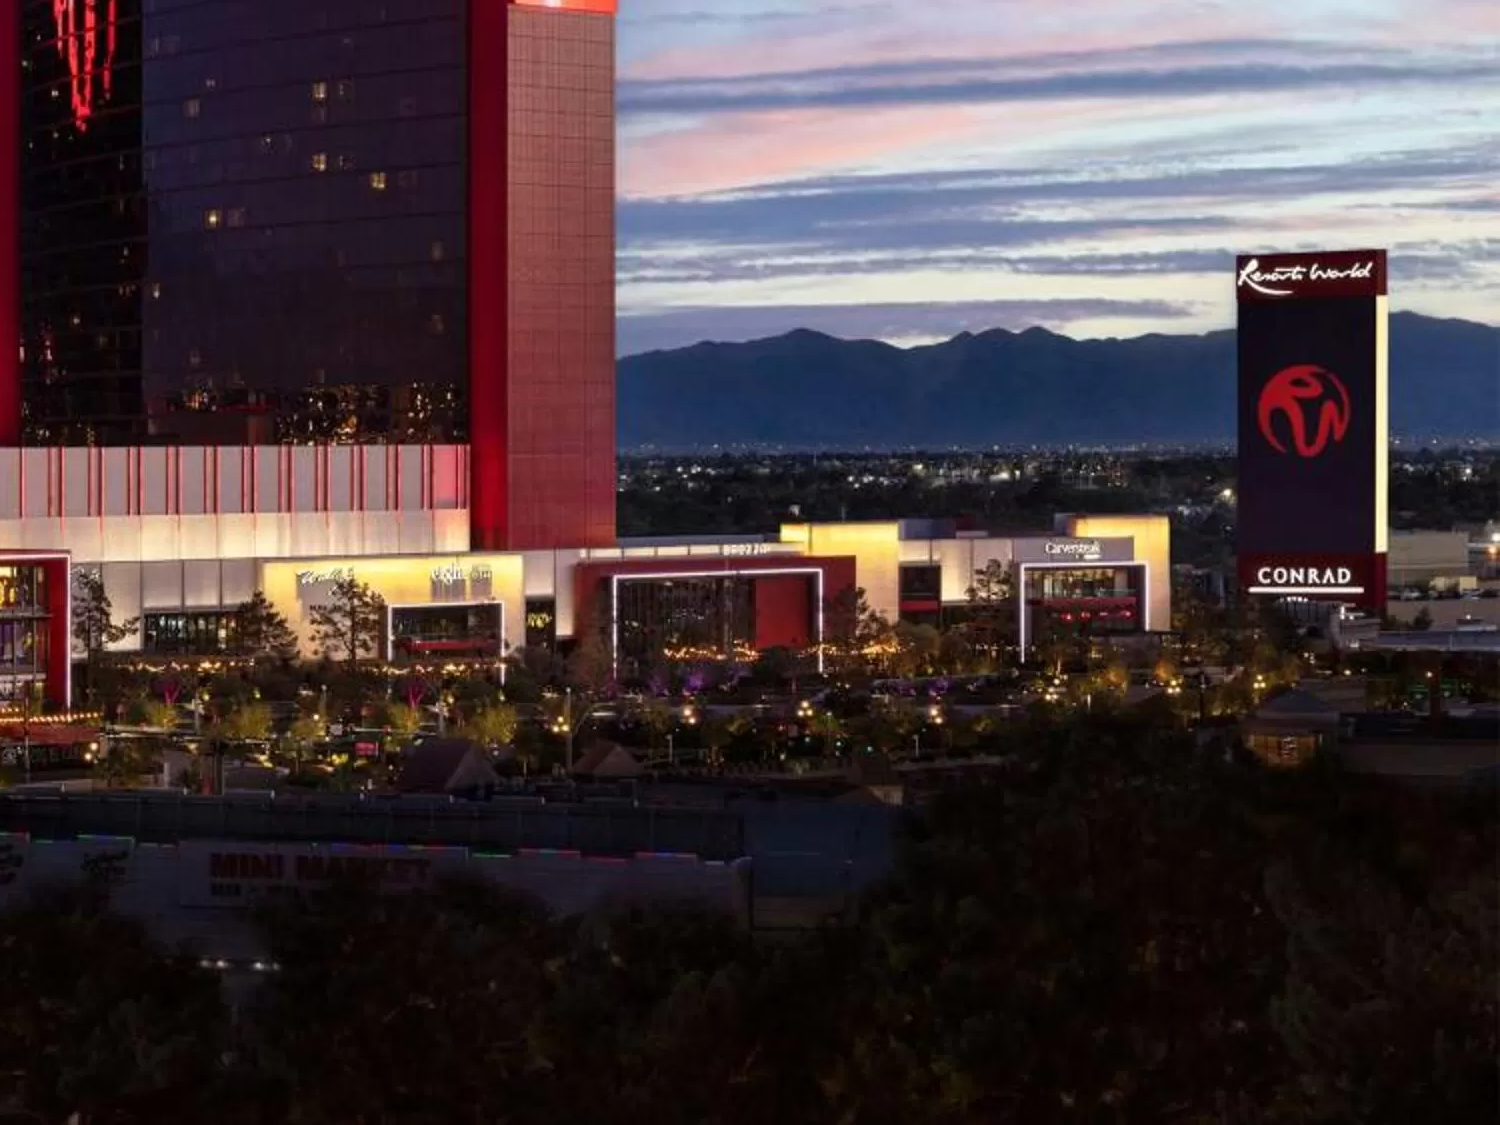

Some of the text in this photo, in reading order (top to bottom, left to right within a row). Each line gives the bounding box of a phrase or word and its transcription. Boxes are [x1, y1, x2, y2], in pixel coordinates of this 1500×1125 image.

[1238, 259, 1373, 295] Resorts World
[1257, 567, 1352, 584] CONRAD
